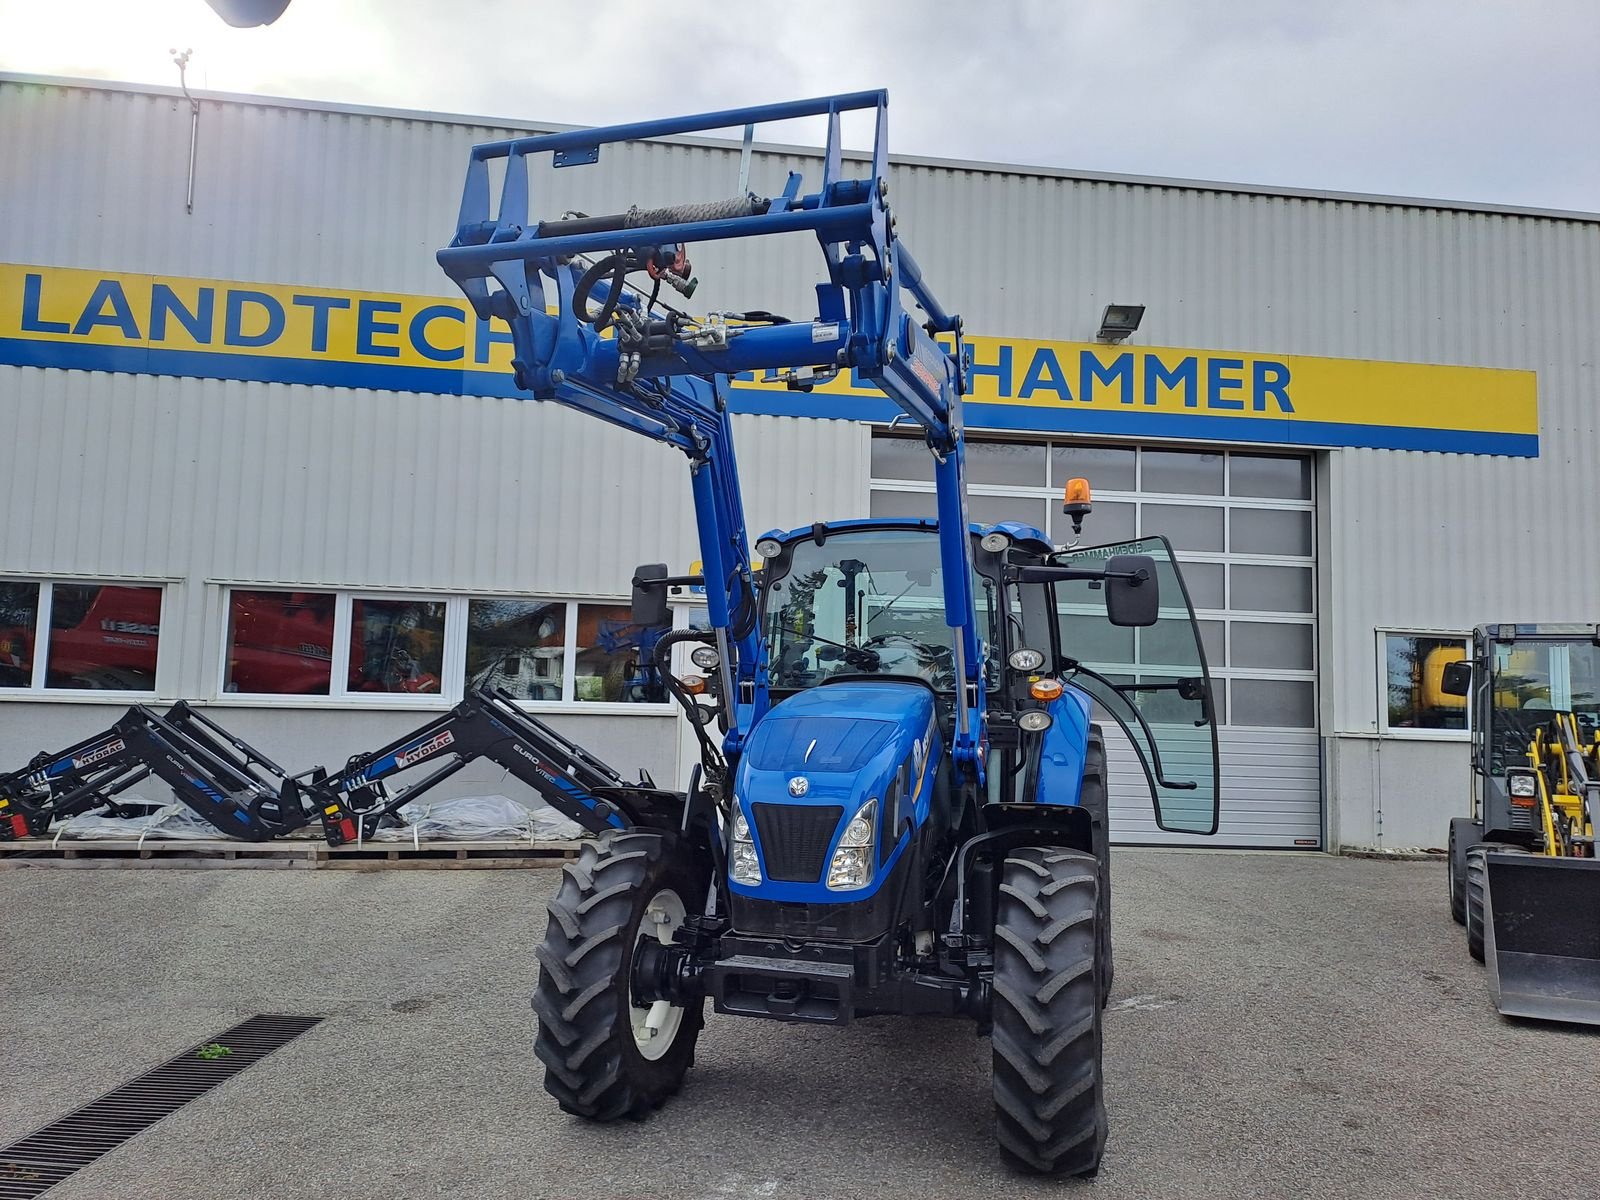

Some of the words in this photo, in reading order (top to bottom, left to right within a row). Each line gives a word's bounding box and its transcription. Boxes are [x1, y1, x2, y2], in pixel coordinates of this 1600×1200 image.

[20, 273, 520, 364] LANDTECH
[730, 341, 1295, 414] HAMMER
[82, 744, 123, 765] HYDRAC
[406, 737, 451, 763] HYDRAC
[513, 743, 540, 765] EURO
[166, 754, 185, 770] EURO
